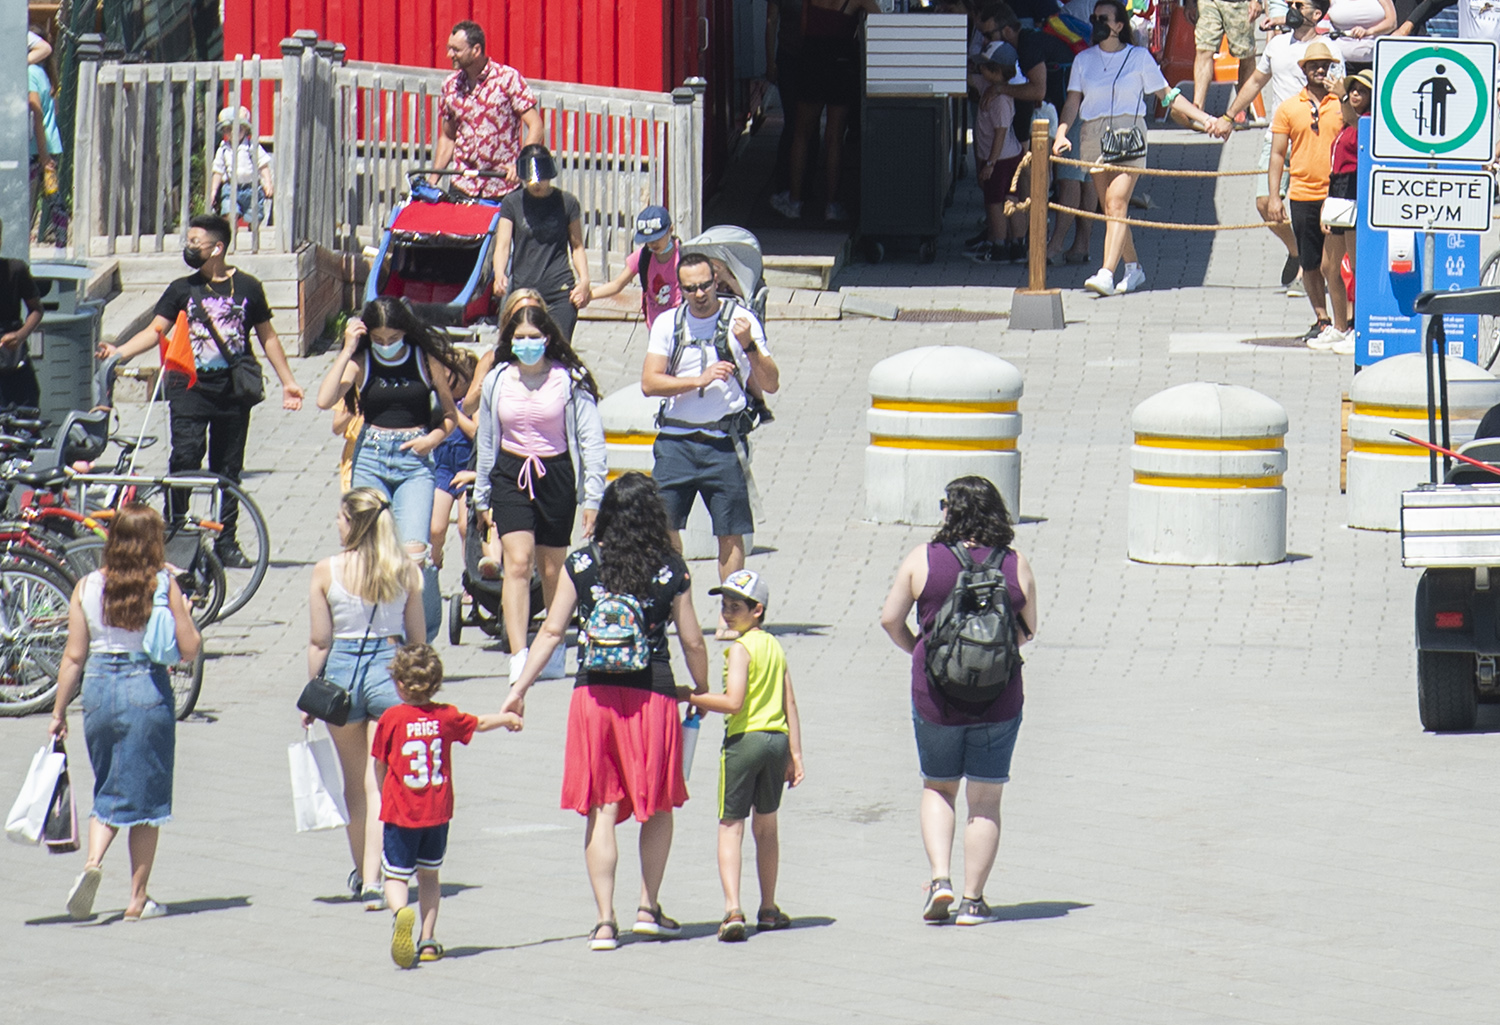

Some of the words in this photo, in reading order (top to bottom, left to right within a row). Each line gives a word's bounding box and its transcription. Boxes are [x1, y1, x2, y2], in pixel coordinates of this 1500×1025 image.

[1382, 179, 1482, 199] EXCEPTÉ
[1400, 203, 1461, 222] SPVM
[406, 720, 439, 738] PRICE
[401, 737, 443, 789] 31
